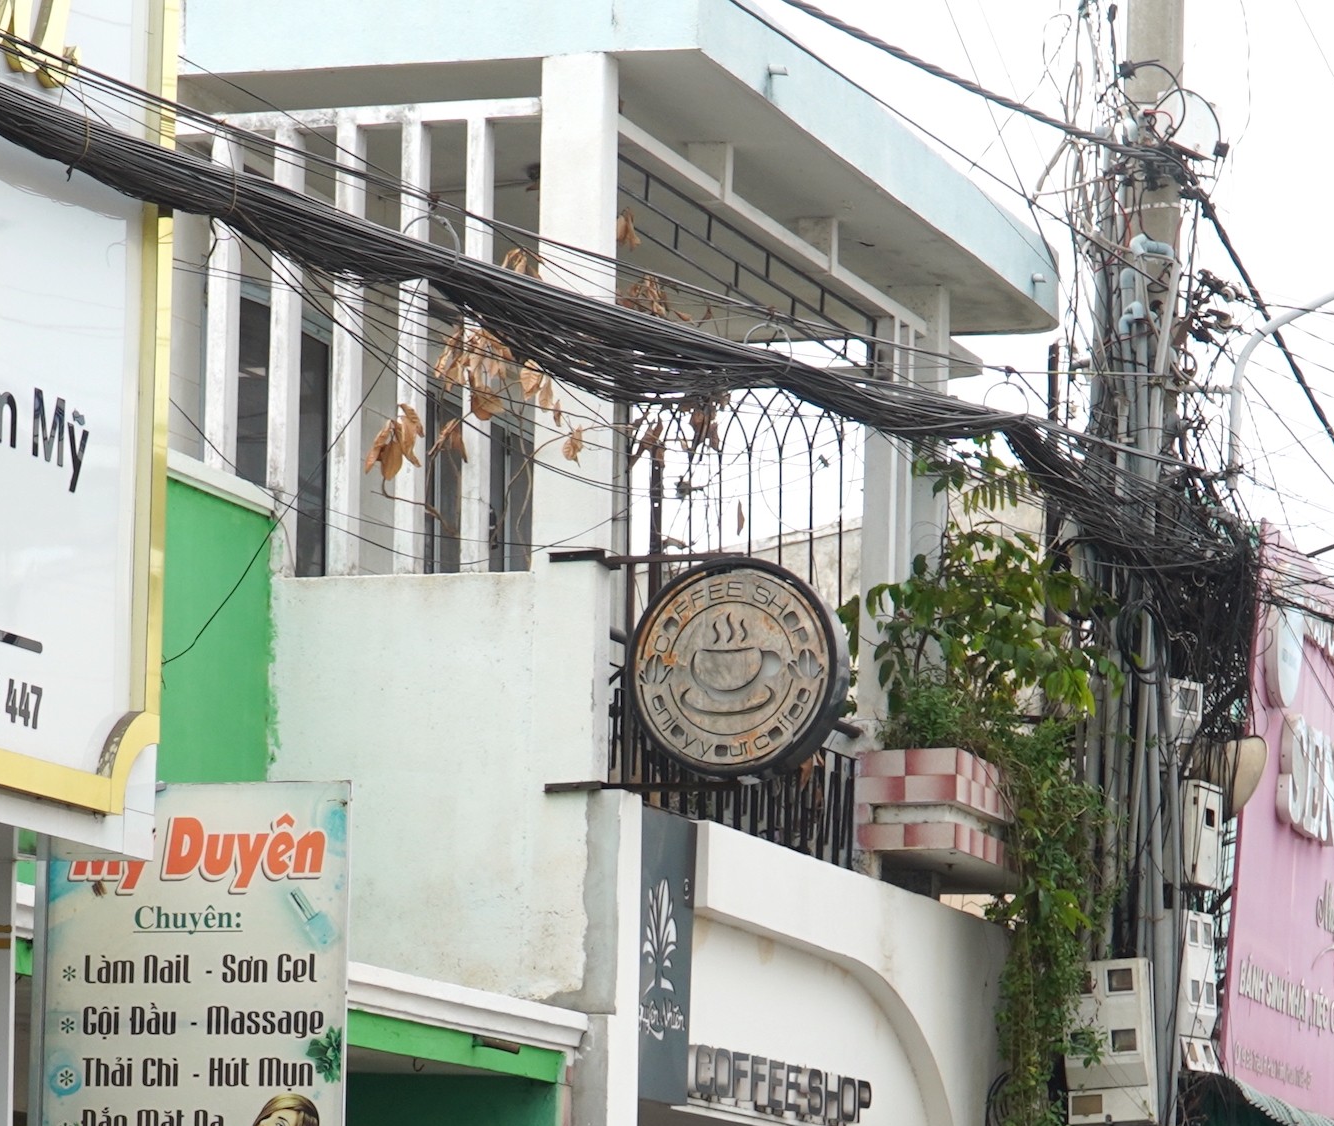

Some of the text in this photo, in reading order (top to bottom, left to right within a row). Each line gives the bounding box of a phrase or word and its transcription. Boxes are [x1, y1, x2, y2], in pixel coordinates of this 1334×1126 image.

[32, 387, 89, 492] Mỹ
[654, 581, 810, 653] COFFEE SHOP
[5, 677, 44, 730] 447
[163, 813, 327, 893] Duyên
[134, 905, 244, 936] Chuyên:
[83, 953, 318, 985] Làm Nail Sơn Gel
[82, 1002, 324, 1041] Gội Đầu Massage
[82, 1056, 314, 1092] Thải Chì Hút Mụn
[689, 1045, 872, 1124] COFFEE SHOP
